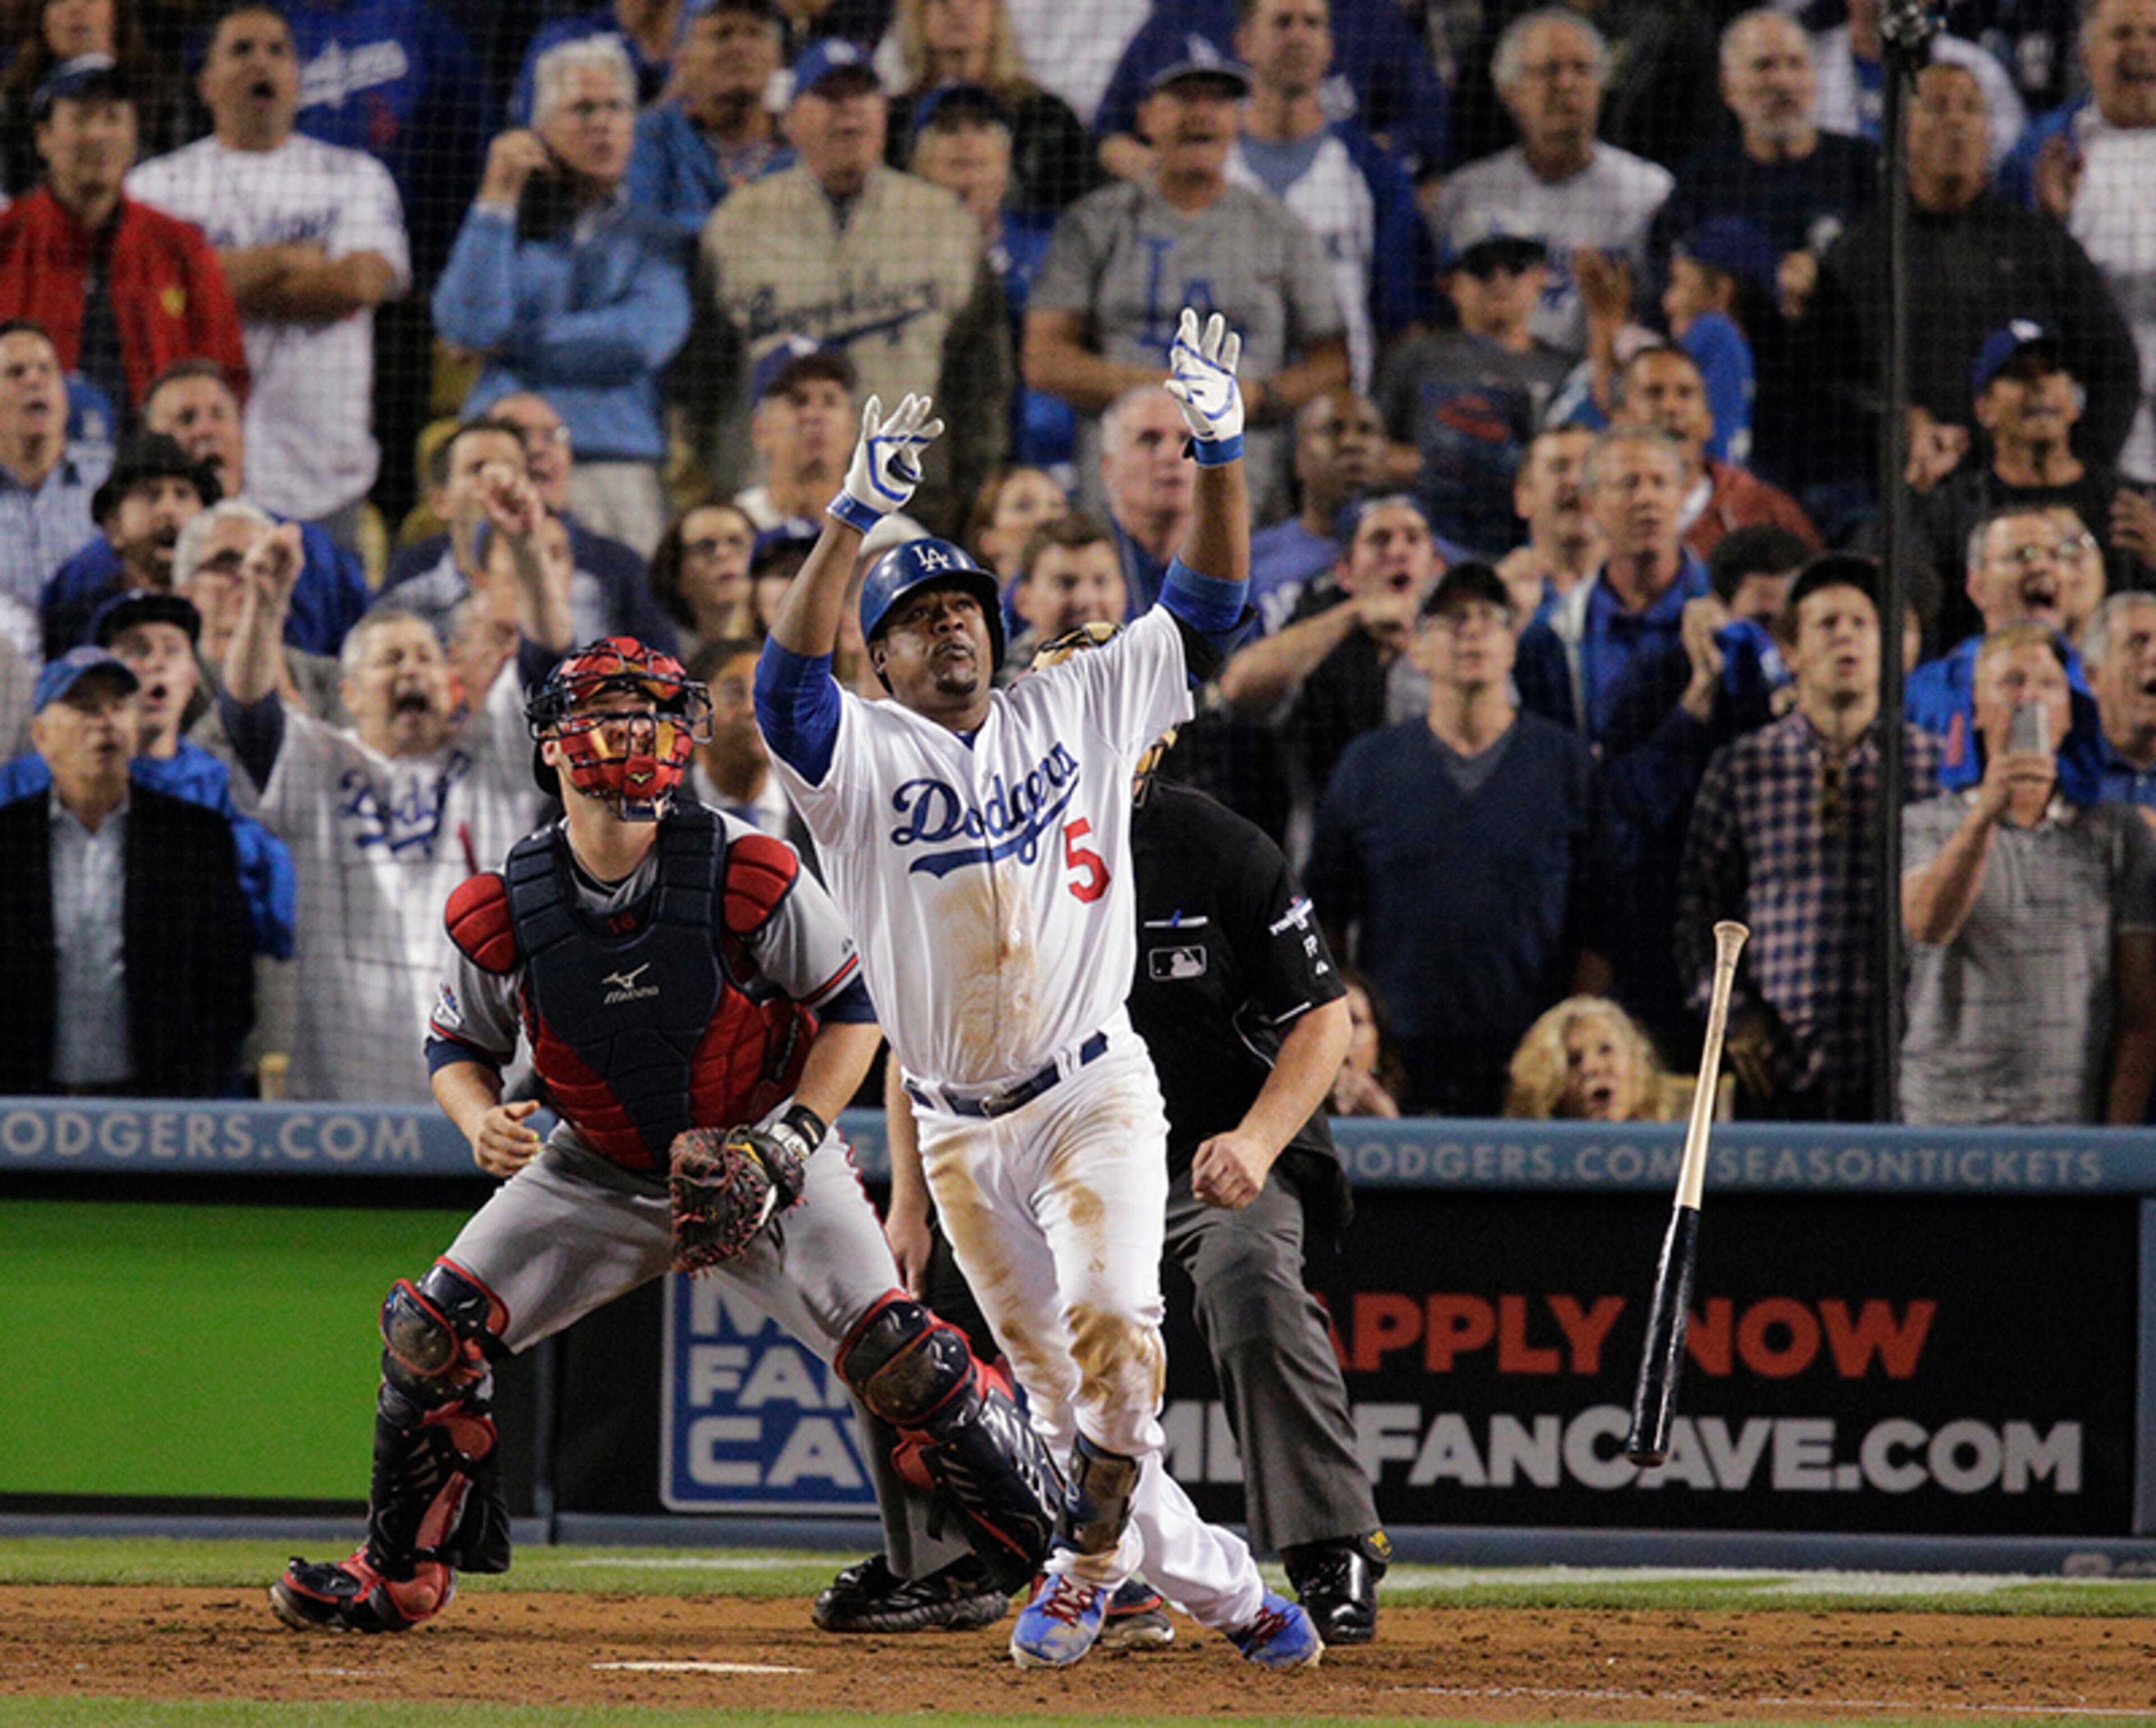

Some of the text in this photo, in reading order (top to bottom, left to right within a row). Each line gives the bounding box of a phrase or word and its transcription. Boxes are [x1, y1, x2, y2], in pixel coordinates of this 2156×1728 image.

[912, 545, 951, 572] LA
[890, 742, 1079, 878] Dodgers
[1063, 816, 1112, 904] 5
[2, 1110, 422, 1161] ODGERS.COM
[1687, 1296, 1938, 1379] NOW
[688, 1416, 865, 1488] CA
